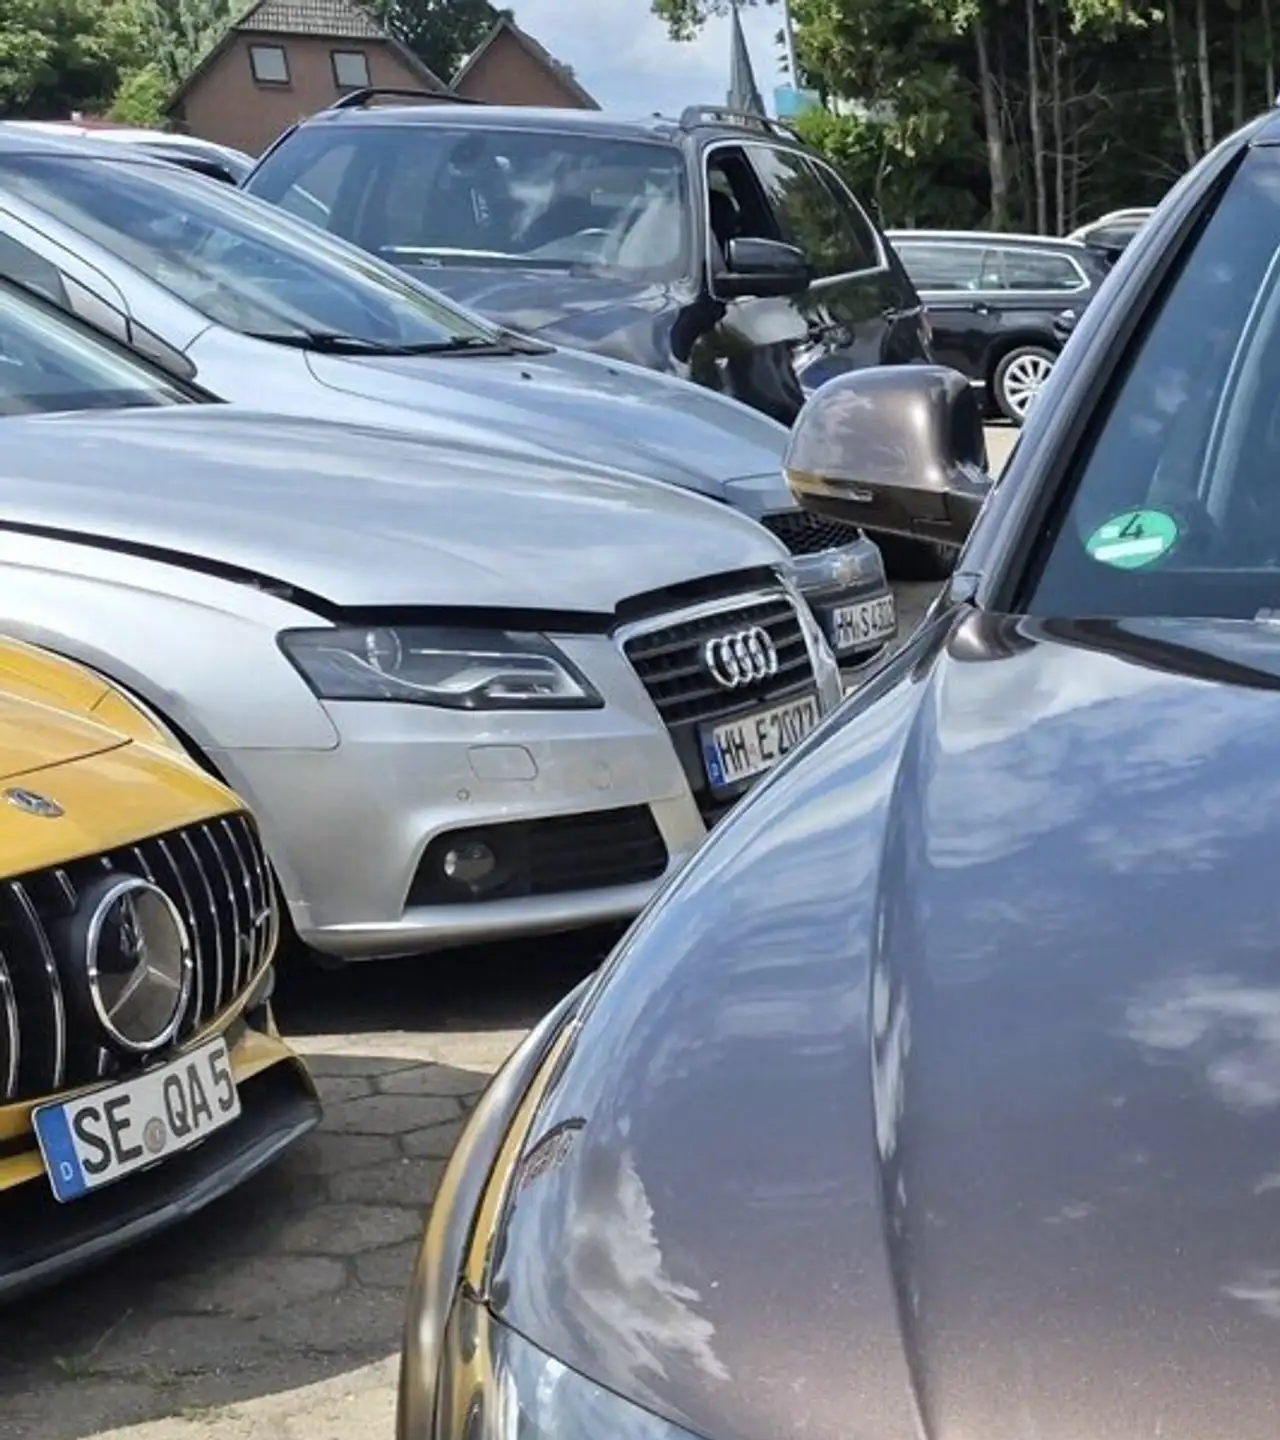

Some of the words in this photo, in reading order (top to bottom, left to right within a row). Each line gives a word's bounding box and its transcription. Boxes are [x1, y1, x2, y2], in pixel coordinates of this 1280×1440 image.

[1118, 512, 1145, 539] 4
[716, 726, 751, 774] HH
[755, 717, 775, 761] E
[72, 1093, 144, 1175] SE
[162, 1062, 214, 1138] QA
[207, 1048, 235, 1113] 5
[59, 1160, 74, 1182] D
